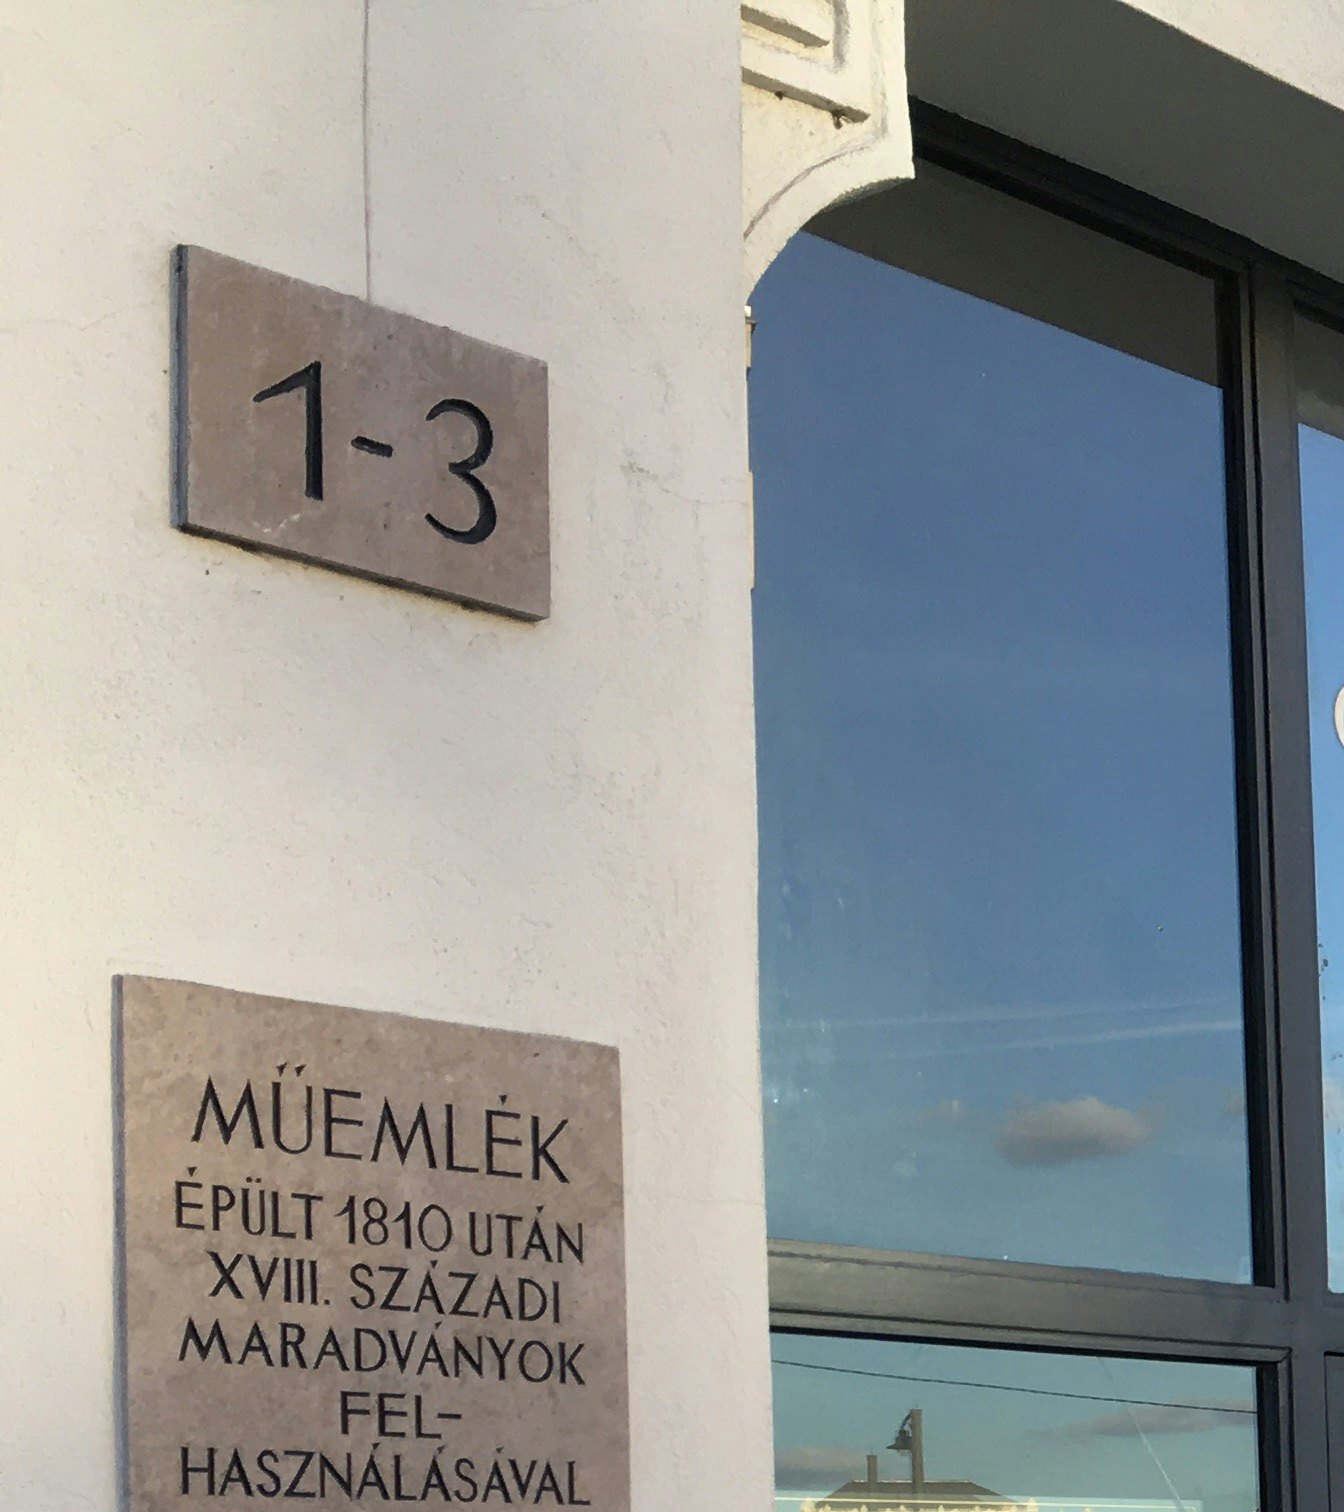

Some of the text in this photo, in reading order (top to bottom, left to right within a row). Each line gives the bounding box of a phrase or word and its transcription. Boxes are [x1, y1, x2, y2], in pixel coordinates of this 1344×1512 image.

[252, 360, 498, 544] 1-3
[191, 1062, 569, 1183] MŰEMLÉK
[174, 1167, 584, 1264] ÉPÜLT 1810 UTÁN
[207, 1251, 561, 1323] XVIII. SZÁZADI
[179, 1315, 586, 1385] MARADVÁNYOK
[340, 1390, 462, 1440] FEL-
[181, 1442, 591, 1506] HASZNÁLÁSÁVAL
